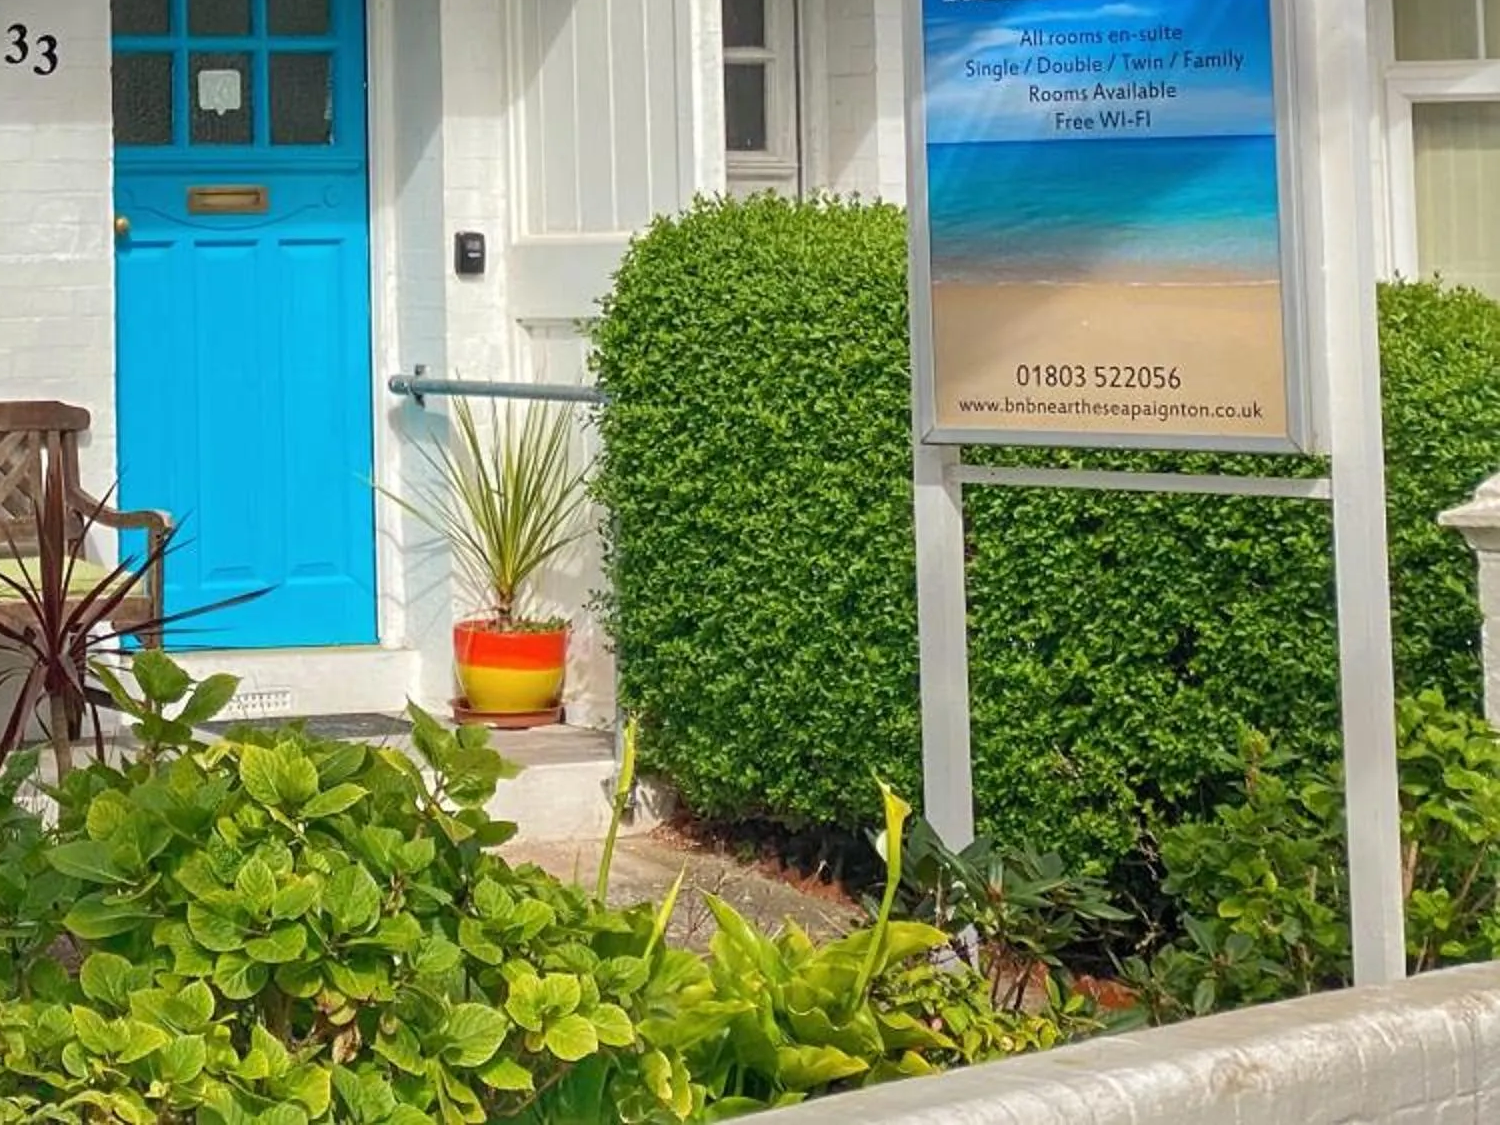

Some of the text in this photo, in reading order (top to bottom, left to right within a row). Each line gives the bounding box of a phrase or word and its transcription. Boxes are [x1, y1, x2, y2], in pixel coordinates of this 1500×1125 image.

[1020, 26, 1183, 47] All rooms en-suite
[4, 23, 59, 76] 33
[965, 59, 1019, 81] Single
[1037, 55, 1101, 74] Double
[1122, 52, 1163, 70] Twin
[1183, 50, 1244, 71] Family
[1029, 80, 1177, 102] Rooms Available
[1055, 112, 1094, 130] Free
[1016, 364, 1182, 390] 01803 522056
[959, 397, 1263, 421] www.bnbneartheseapaignton.co.uk
